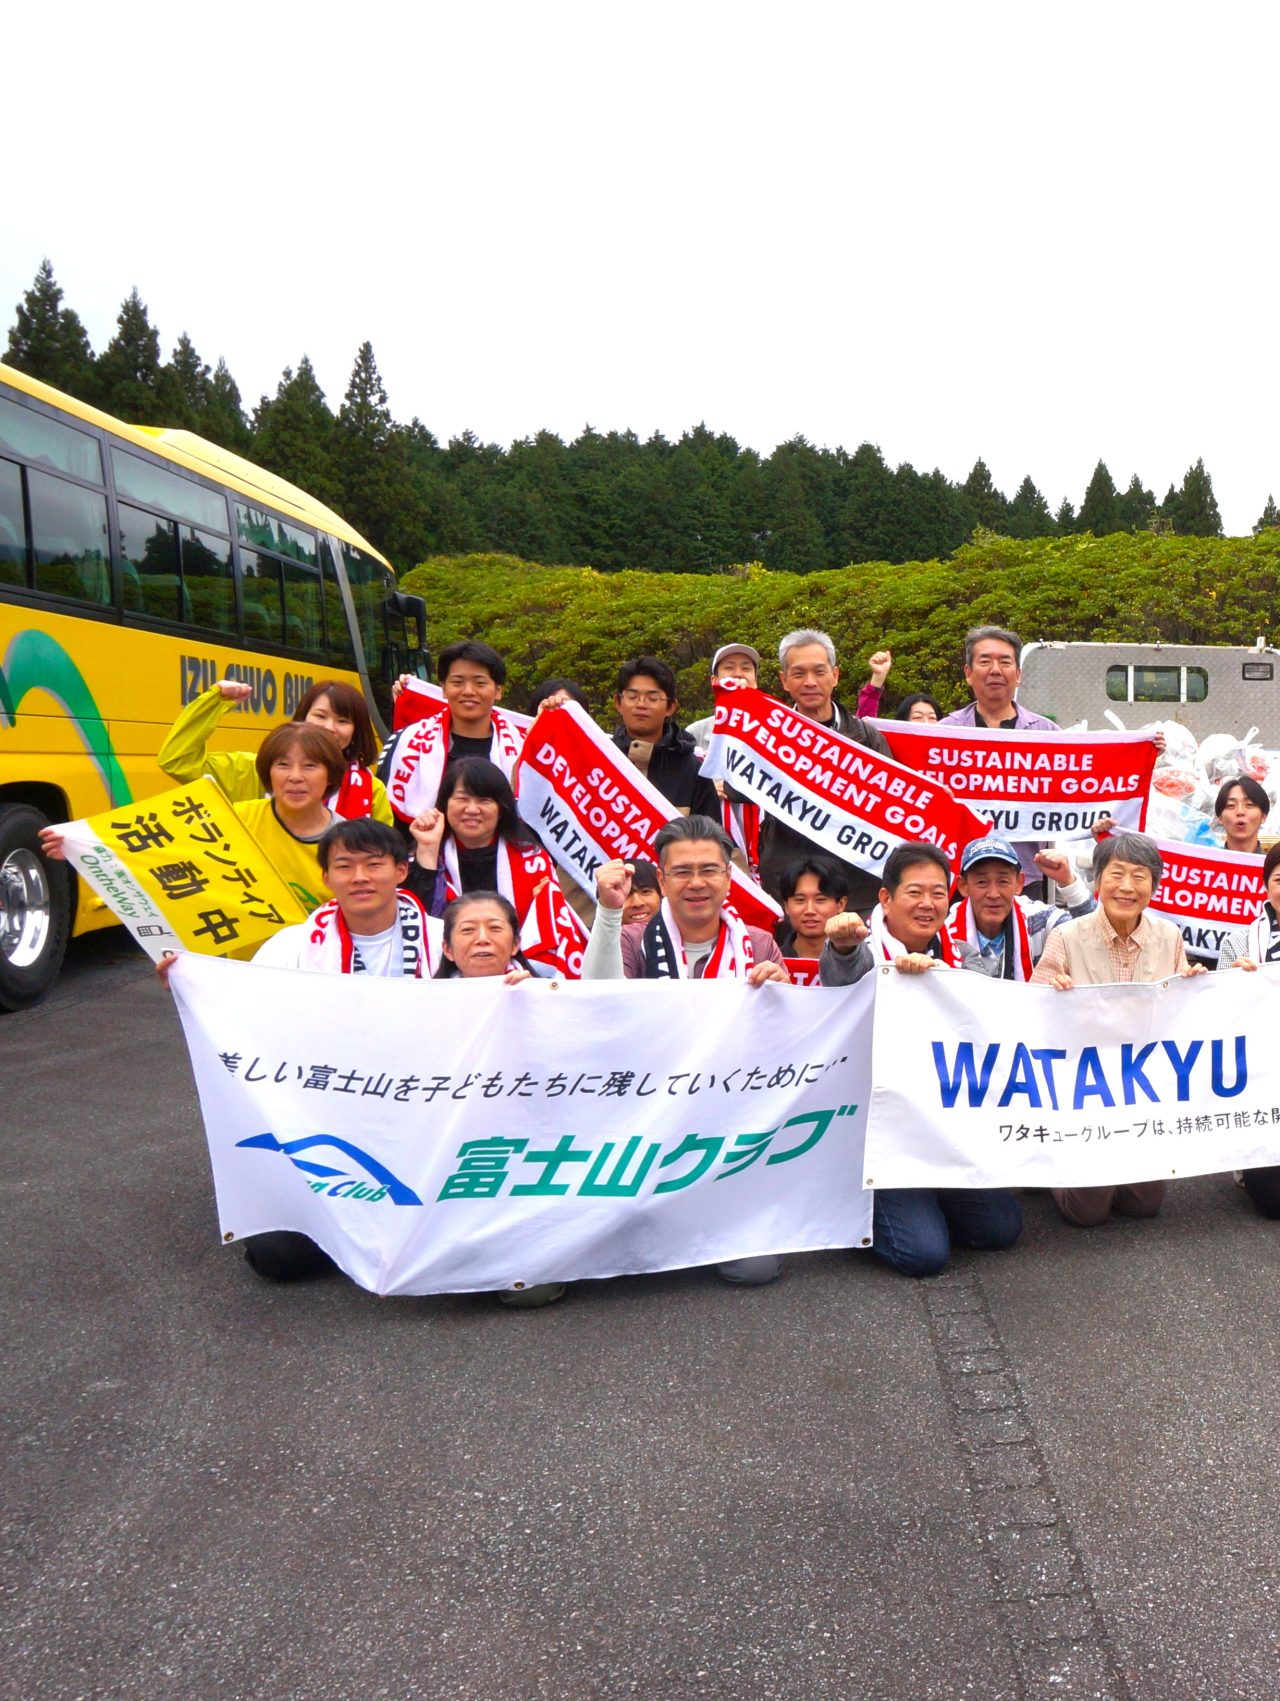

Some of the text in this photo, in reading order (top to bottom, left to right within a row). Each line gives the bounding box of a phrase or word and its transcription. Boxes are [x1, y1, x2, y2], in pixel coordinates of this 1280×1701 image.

[283, 672, 314, 716] BU
[714, 705, 958, 861] DEVELOPMENT GOALS
[766, 708, 934, 810] SUSTAINABLE
[918, 769, 1140, 795] ELOPMENT GOALS
[928, 747, 1094, 772] SUSTAINABLE
[535, 742, 655, 866] DEVELOPM
[539, 796, 603, 881] WATAK
[586, 767, 660, 846] SUSTAI
[726, 746, 897, 861] WATAKYU GRO
[80, 855, 140, 918] OntheWay
[111, 812, 240, 945] 活動中
[172, 796, 285, 925] ボランティア
[1161, 862, 1268, 894] SUSTAIN
[1151, 885, 1263, 917] ELOPMEN
[931, 1035, 1248, 1111] WATAKYU
[327, 1180, 390, 1203] Club
[436, 1105, 858, 1203] 富士山クラブ
